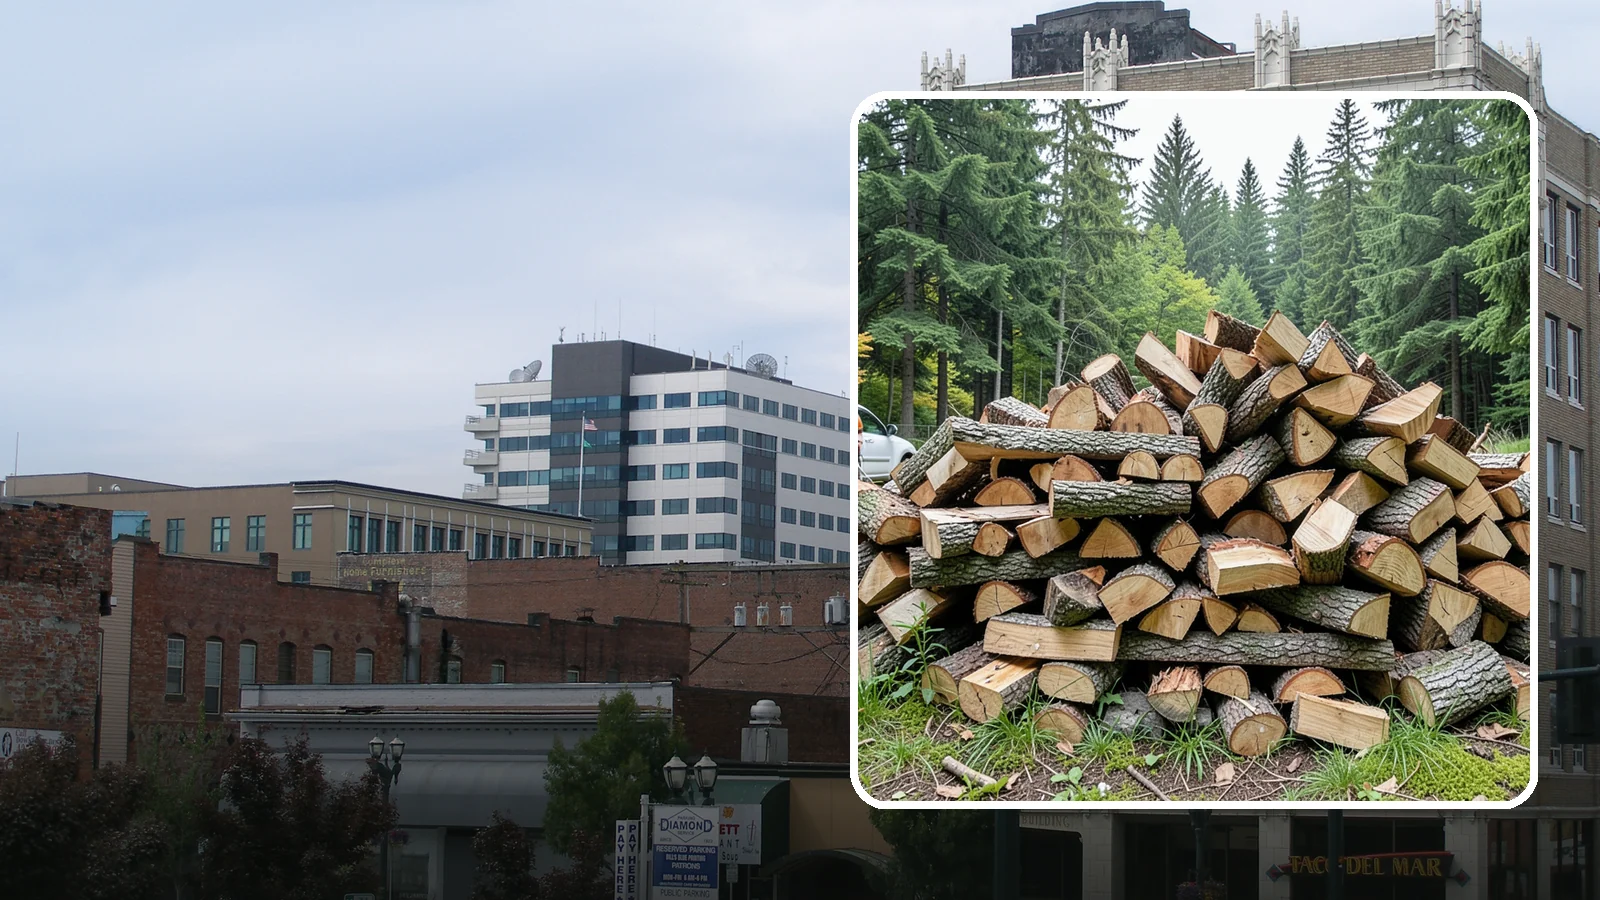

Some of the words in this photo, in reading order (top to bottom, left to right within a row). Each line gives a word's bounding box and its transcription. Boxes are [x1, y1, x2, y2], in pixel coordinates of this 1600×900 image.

[343, 568, 368, 577] Home
[370, 566, 427, 577] Furnishers
[660, 818, 713, 832] DIAMOND
[1021, 815, 1070, 828] BUILDING
[617, 825, 625, 852] PAY
[628, 825, 637, 852] PAY
[721, 851, 739, 862] Soup
[671, 862, 701, 870] PATRONS
[1345, 856, 1385, 875] DEL
[1392, 857, 1442, 877] MAR
[616, 856, 625, 893] HERE
[627, 856, 636, 893] HERE
[660, 888, 682, 896] PUBLIC
[683, 889, 710, 898] PARKING
